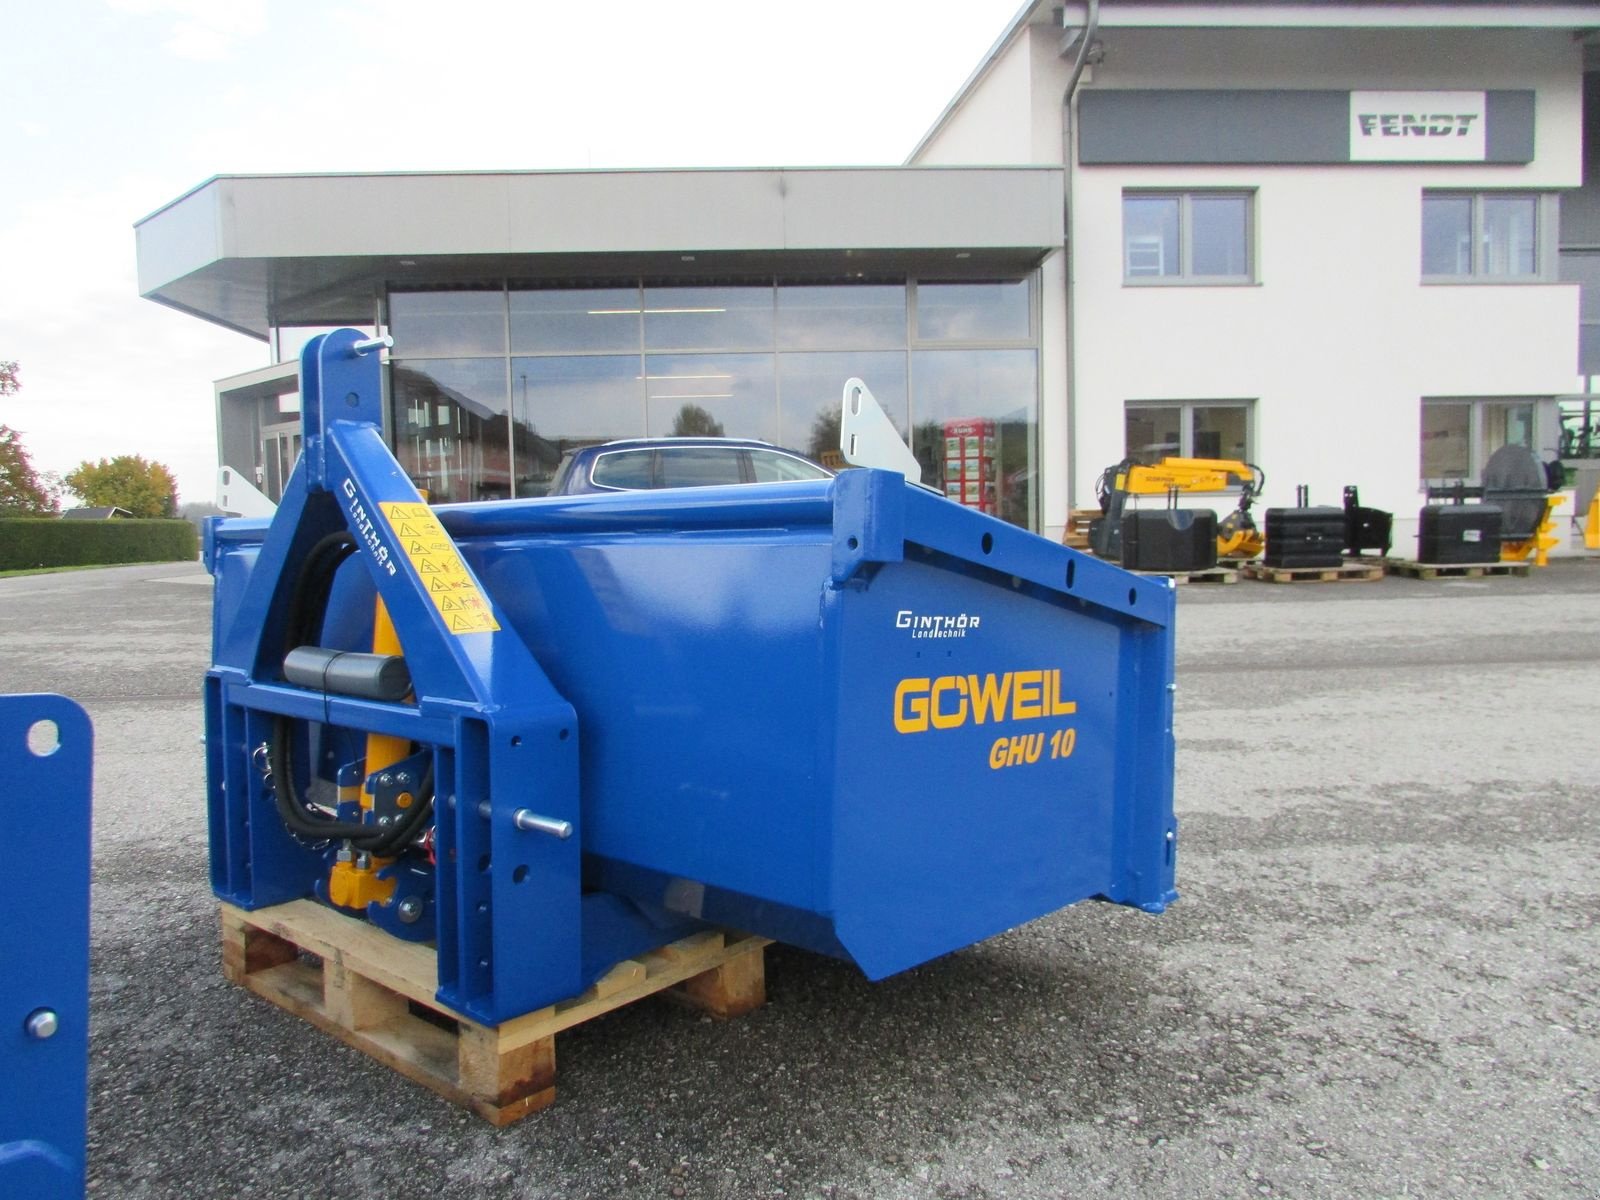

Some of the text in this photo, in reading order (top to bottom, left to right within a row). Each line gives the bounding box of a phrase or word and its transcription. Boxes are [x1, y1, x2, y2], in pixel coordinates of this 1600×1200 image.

[1358, 114, 1478, 136] FENDT
[896, 610, 980, 629] GINTHÖR
[989, 728, 1076, 770] GHU 10
